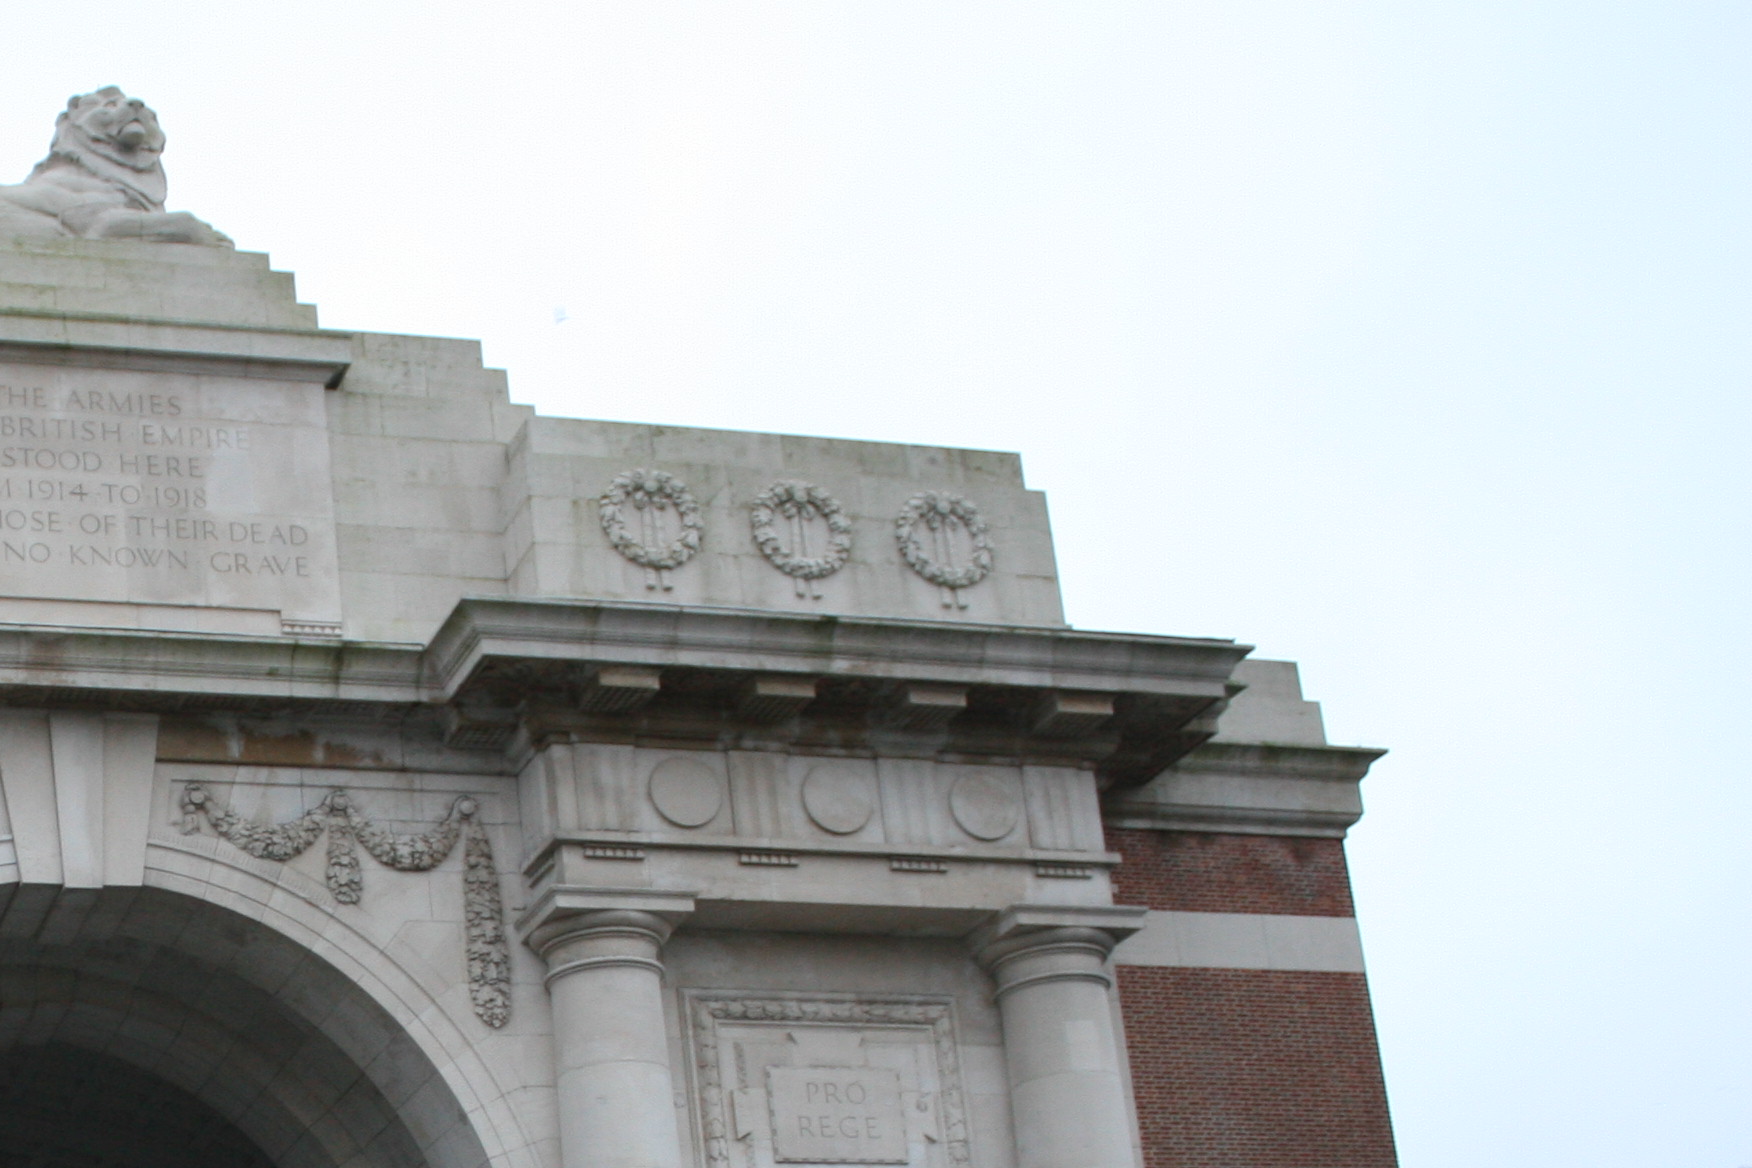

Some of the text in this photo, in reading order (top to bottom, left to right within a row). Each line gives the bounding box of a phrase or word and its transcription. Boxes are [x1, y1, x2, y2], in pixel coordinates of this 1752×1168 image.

[68, 390, 182, 416] ARMIES
[0, 416, 121, 442] BRITISH
[141, 424, 249, 450] EMPIRE
[2, 447, 102, 471] STOOD
[120, 454, 204, 477] HERE
[28, 478, 88, 501] 1914
[101, 483, 140, 504] TO
[154, 486, 207, 509] 1918
[79, 513, 116, 537] OF
[128, 516, 218, 541] THEIR
[228, 521, 308, 546] DEAD
[2, 541, 50, 563] NO
[69, 544, 188, 570] KNOWN
[210, 551, 308, 577] GRAVE
[806, 1081, 866, 1104] PRO
[798, 1115, 882, 1139] REGE
